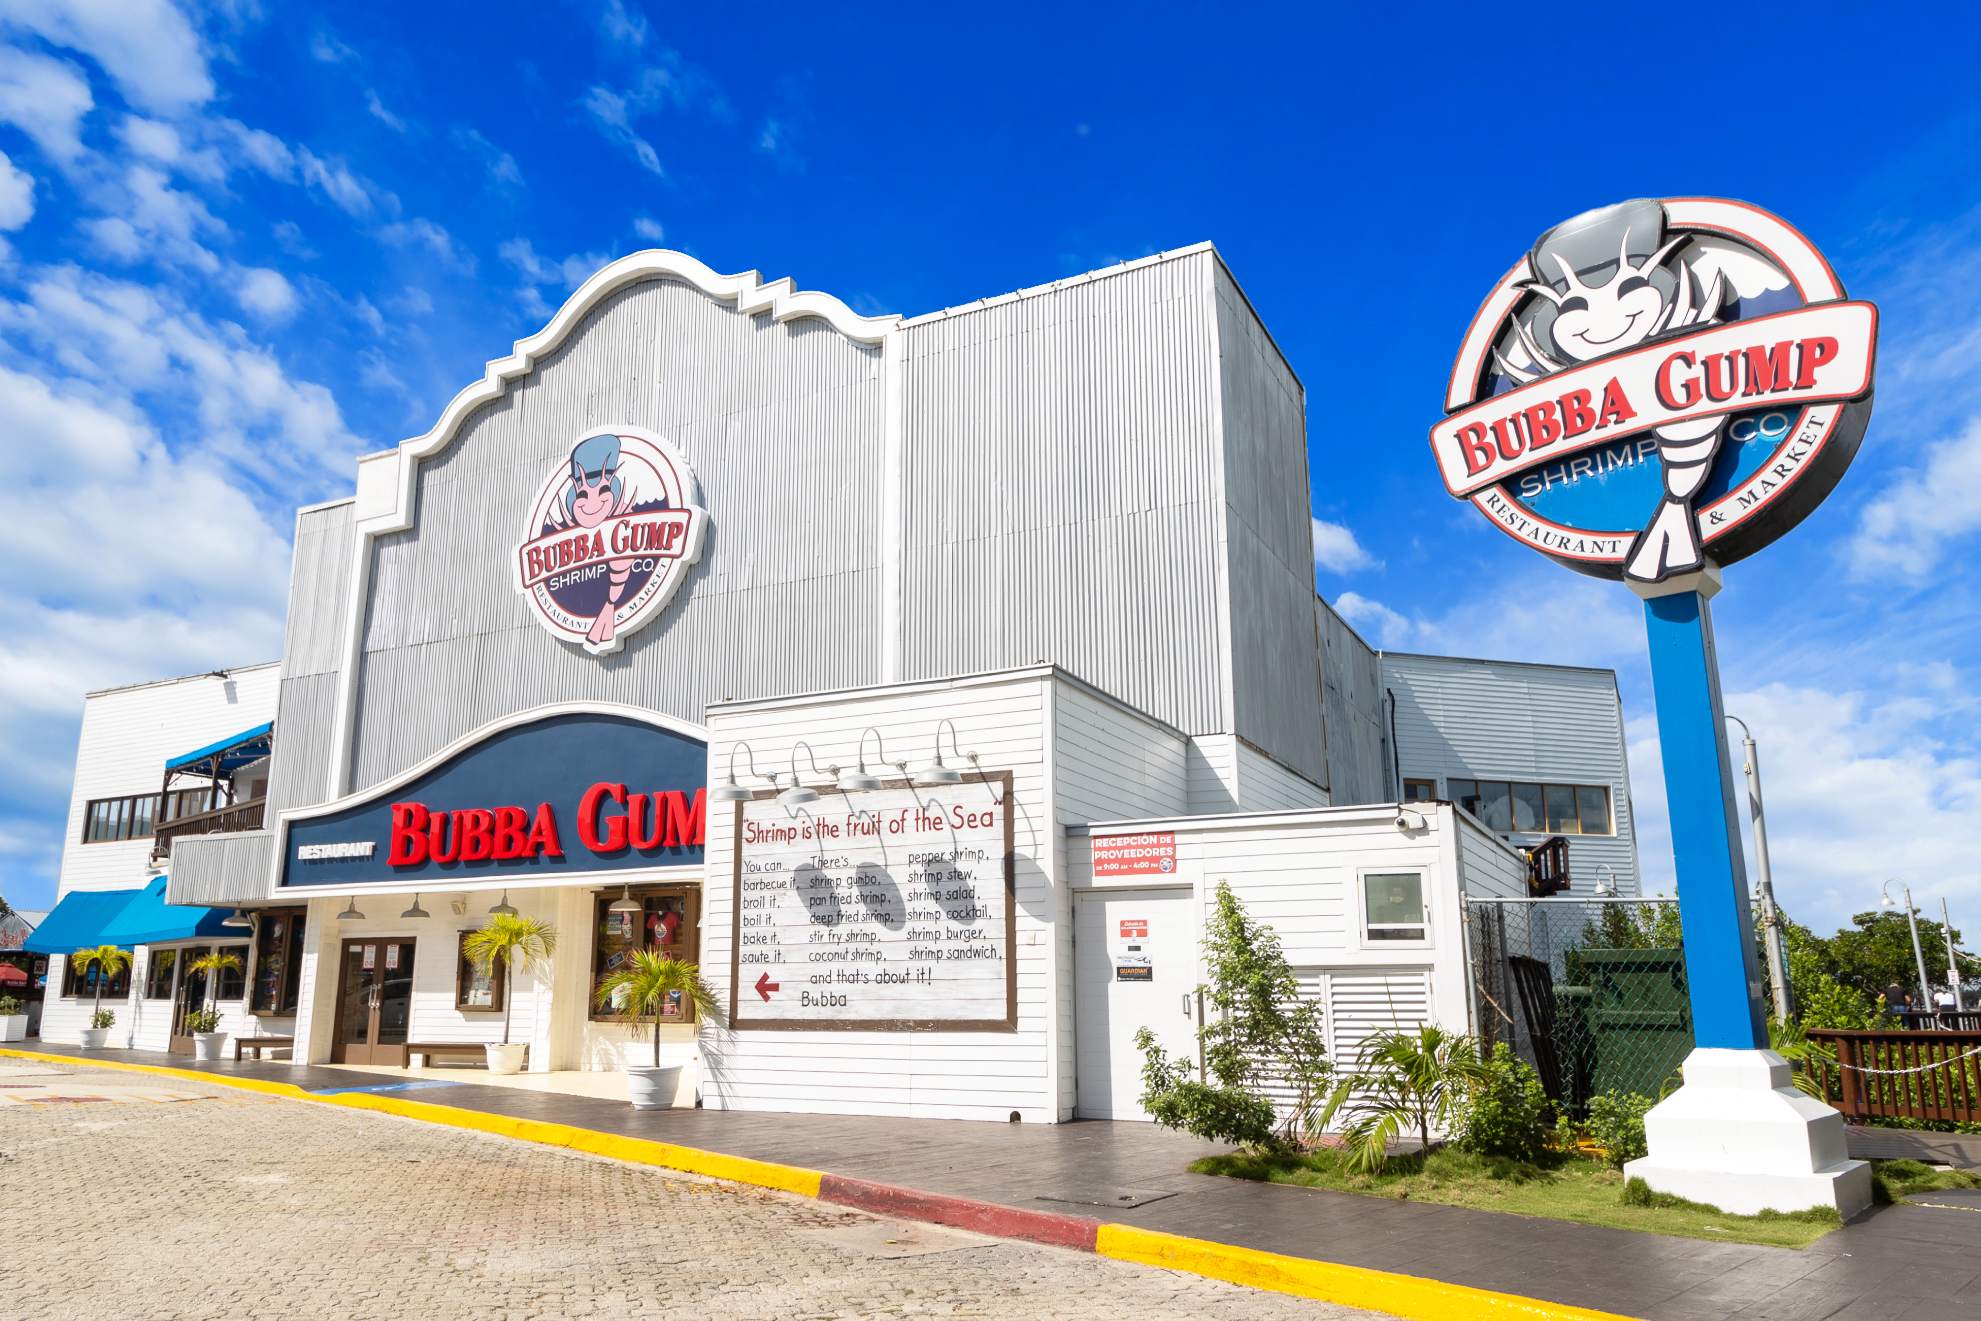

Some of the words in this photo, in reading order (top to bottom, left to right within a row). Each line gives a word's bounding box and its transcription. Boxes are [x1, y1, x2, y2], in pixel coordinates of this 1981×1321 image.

[1455, 375, 1638, 477] BUBBA
[1655, 334, 1839, 411] GUMP
[1519, 438, 1660, 497] SHRIMP
[1486, 492, 1623, 554] RESTAURANT
[1708, 509, 1728, 526] &
[1735, 414, 1827, 512] MARKET
[526, 528, 606, 581] BUBBA
[611, 519, 685, 555] GUMP
[549, 563, 607, 592] SHRIMP
[536, 584, 592, 630] RESTAURANT
[616, 612, 625, 621] &
[628, 560, 667, 613] MARKET
[386, 801, 565, 866] BUBBA
[577, 781, 707, 853] GUM
[802, 820, 812, 840] is
[816, 816, 839, 839] the
[846, 811, 882, 837] fruit
[889, 809, 908, 834] of
[915, 807, 944, 833] the
[1095, 834, 1157, 848] RECEPCIÓN
[1160, 835, 1172, 844] DE
[297, 841, 377, 860] RESTAURANT
[1094, 847, 1174, 860] PROVEEDORES
[744, 860, 762, 873] You
[908, 851, 945, 868] pepper
[744, 877, 787, 891] barbecue
[809, 873, 842, 890] shrimp
[907, 866, 943, 886] shrimp
[744, 895, 765, 909] broil
[809, 895, 827, 909] pan
[829, 892, 852, 906] fried
[907, 887, 942, 905] shrimp
[744, 914, 762, 927] boil
[809, 911, 834, 928] deep
[837, 909, 859, 923] fried
[907, 907, 941, 924] shrimp
[743, 931, 767, 945] bake
[809, 930, 824, 943] stir
[828, 929, 842, 946] fry
[906, 927, 941, 944] shrimp
[742, 950, 770, 964] saute
[809, 949, 849, 962] coconut
[908, 946, 944, 964] shrimp
[810, 969, 832, 985] and
[837, 968, 870, 984] that's
[875, 967, 911, 985] about
[916, 966, 932, 986] it!
[801, 990, 847, 1008] Bubba
